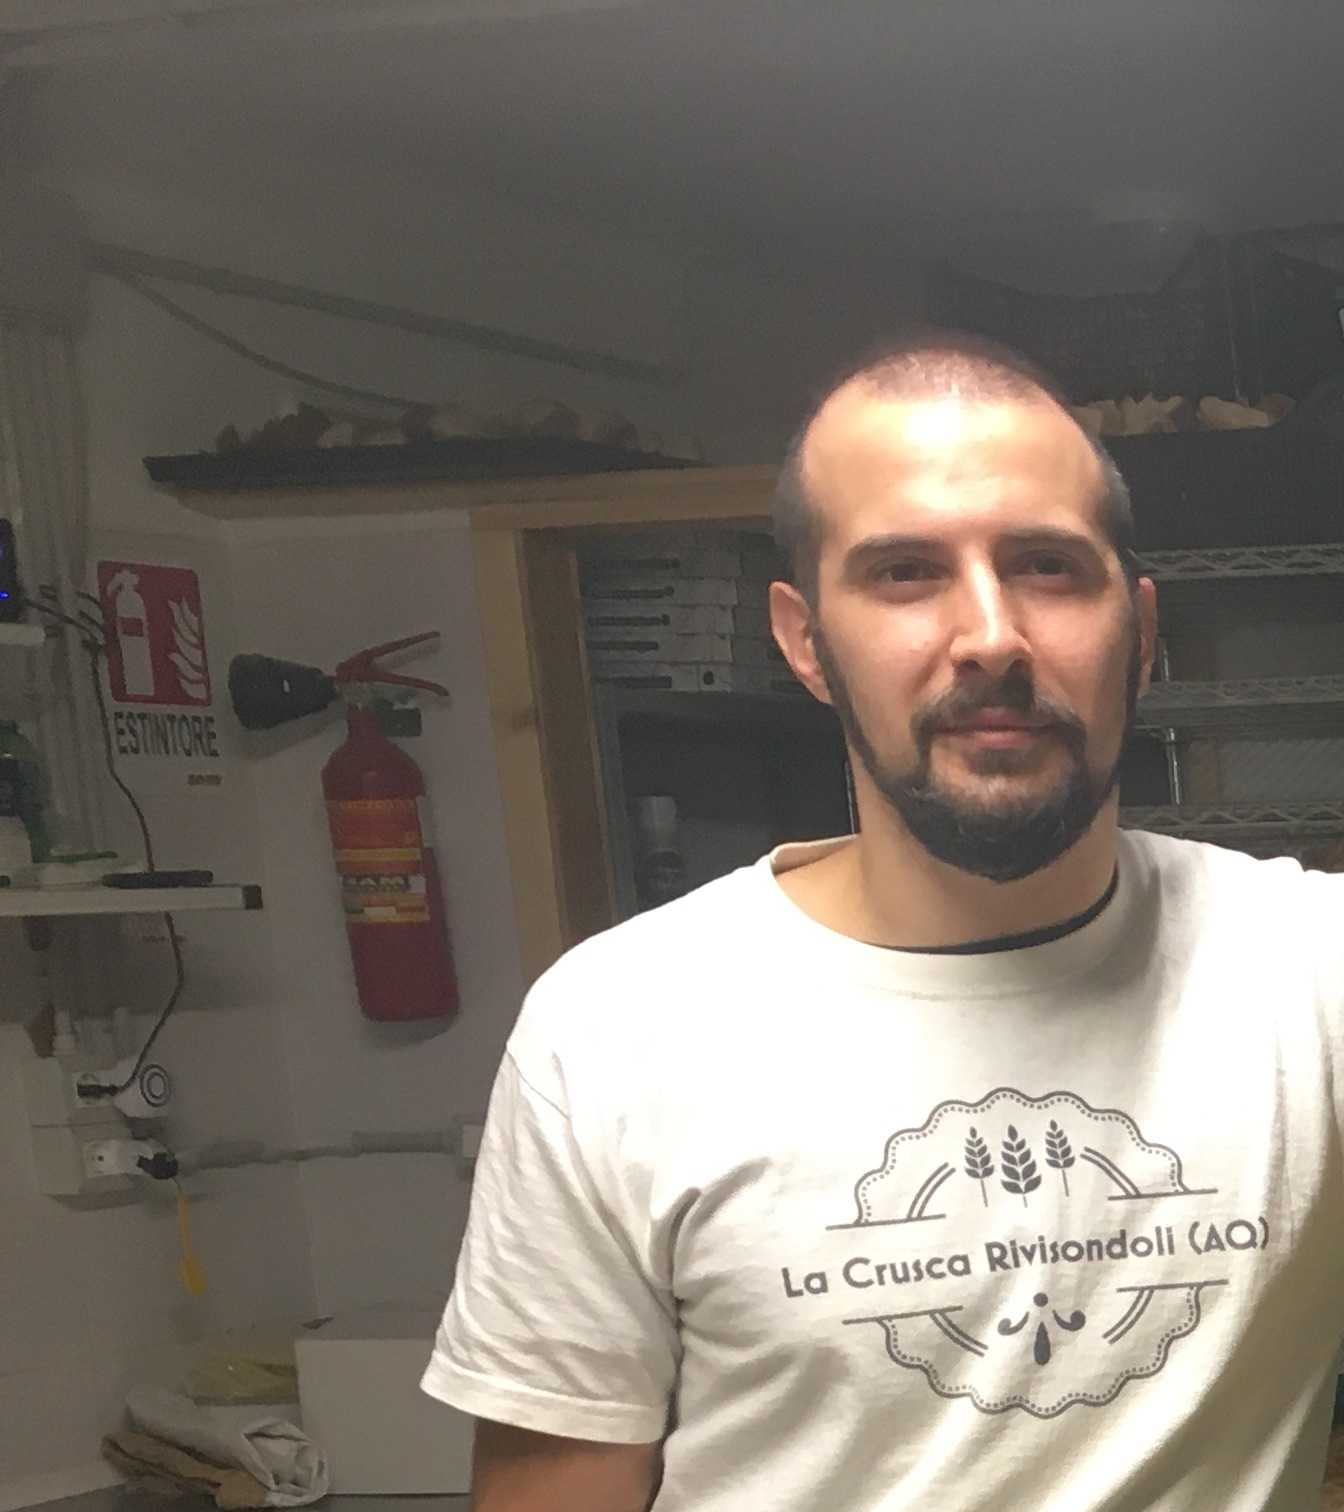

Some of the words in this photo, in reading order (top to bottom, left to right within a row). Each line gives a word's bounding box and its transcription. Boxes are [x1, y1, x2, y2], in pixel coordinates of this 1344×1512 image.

[115, 712, 219, 758] ESTINTORE
[782, 1267, 827, 1298] La
[842, 1253, 971, 1290] Crusca
[985, 1225, 1175, 1273] Rivisondoli
[1188, 1216, 1270, 1253] (AQ)
